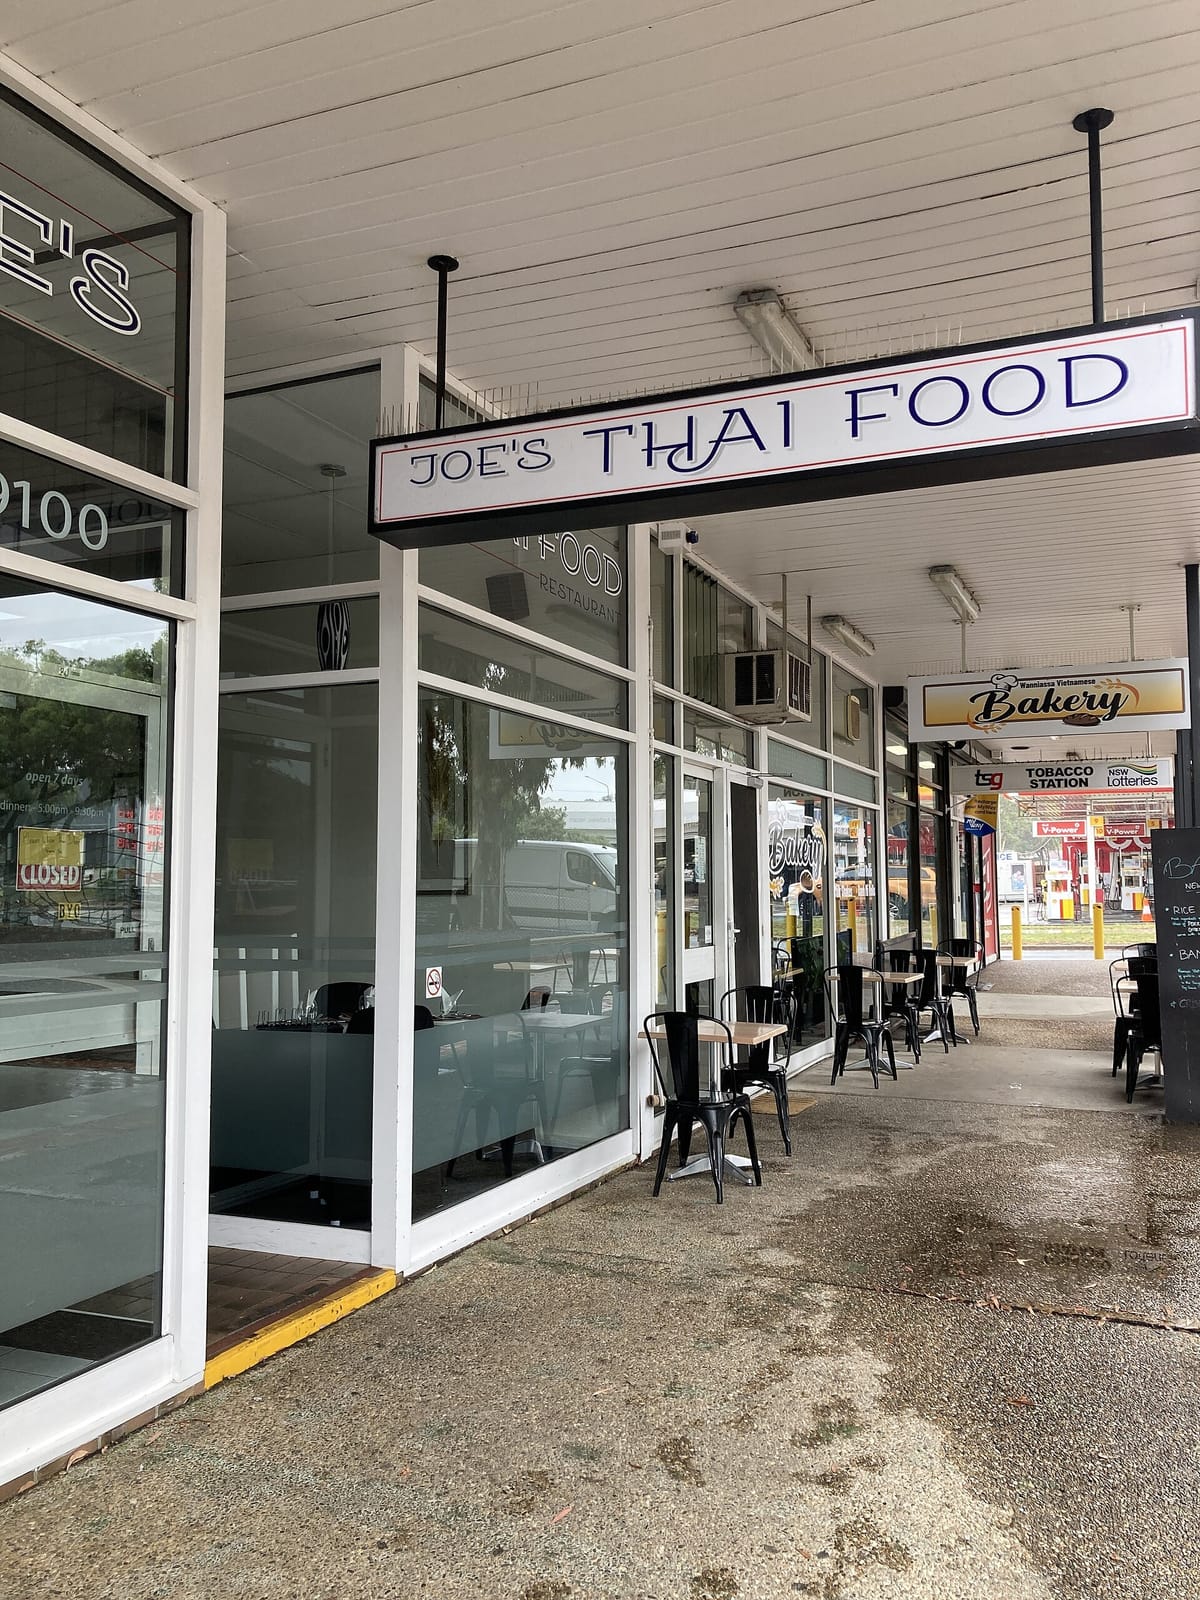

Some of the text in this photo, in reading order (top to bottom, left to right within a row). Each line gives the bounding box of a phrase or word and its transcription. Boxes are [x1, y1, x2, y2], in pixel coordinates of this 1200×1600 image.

[410, 353, 1129, 485] JOE'S THAI FOOD
[540, 573, 621, 623] RESTAURANT
[1020, 679, 1096, 689] Wanniassa Vietnamese
[969, 687, 1129, 724] Bakery
[1026, 766, 1094, 778] TOBACCO
[26, 772, 83, 787] open 7 days
[974, 769, 1003, 790] tsg
[1030, 778, 1089, 789] STATION
[1107, 775, 1158, 787] Lotteries
[1042, 826, 1079, 834] V-Power
[20, 864, 80, 885] CLOSED
[1173, 905, 1196, 915] RICE
